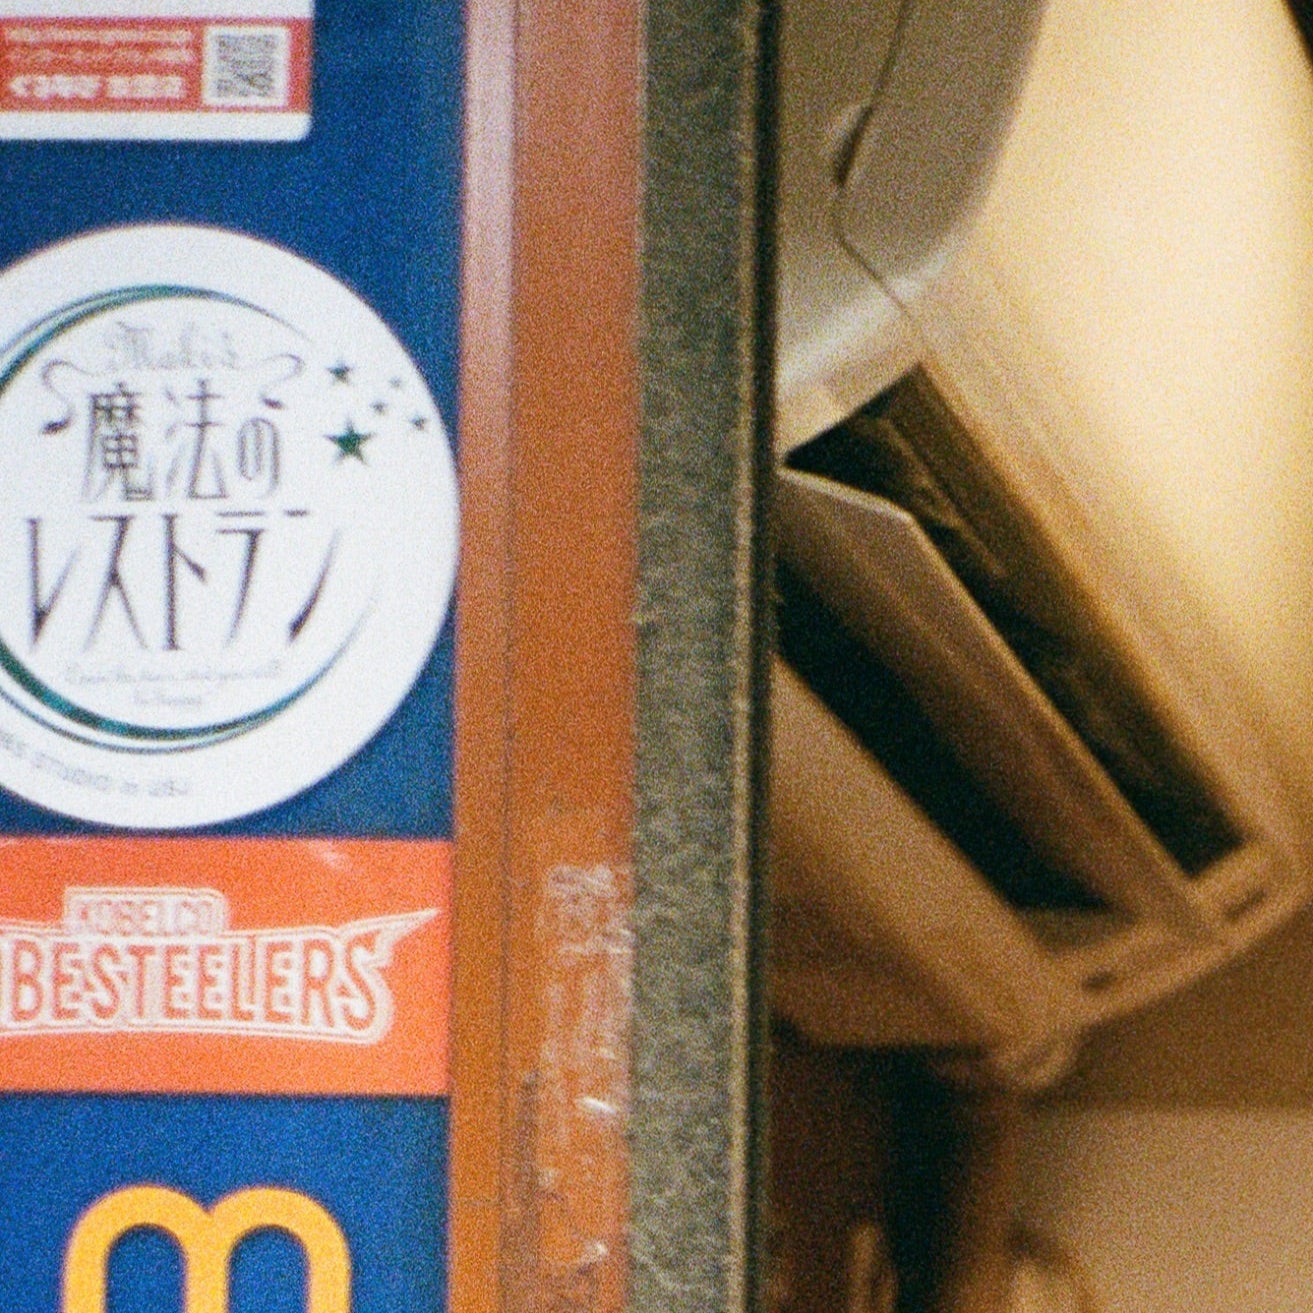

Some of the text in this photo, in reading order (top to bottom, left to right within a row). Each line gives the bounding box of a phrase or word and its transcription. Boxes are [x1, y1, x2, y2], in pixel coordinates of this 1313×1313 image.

[82, 378, 282, 502] 魔法の
[25, 508, 342, 652] レストラン
